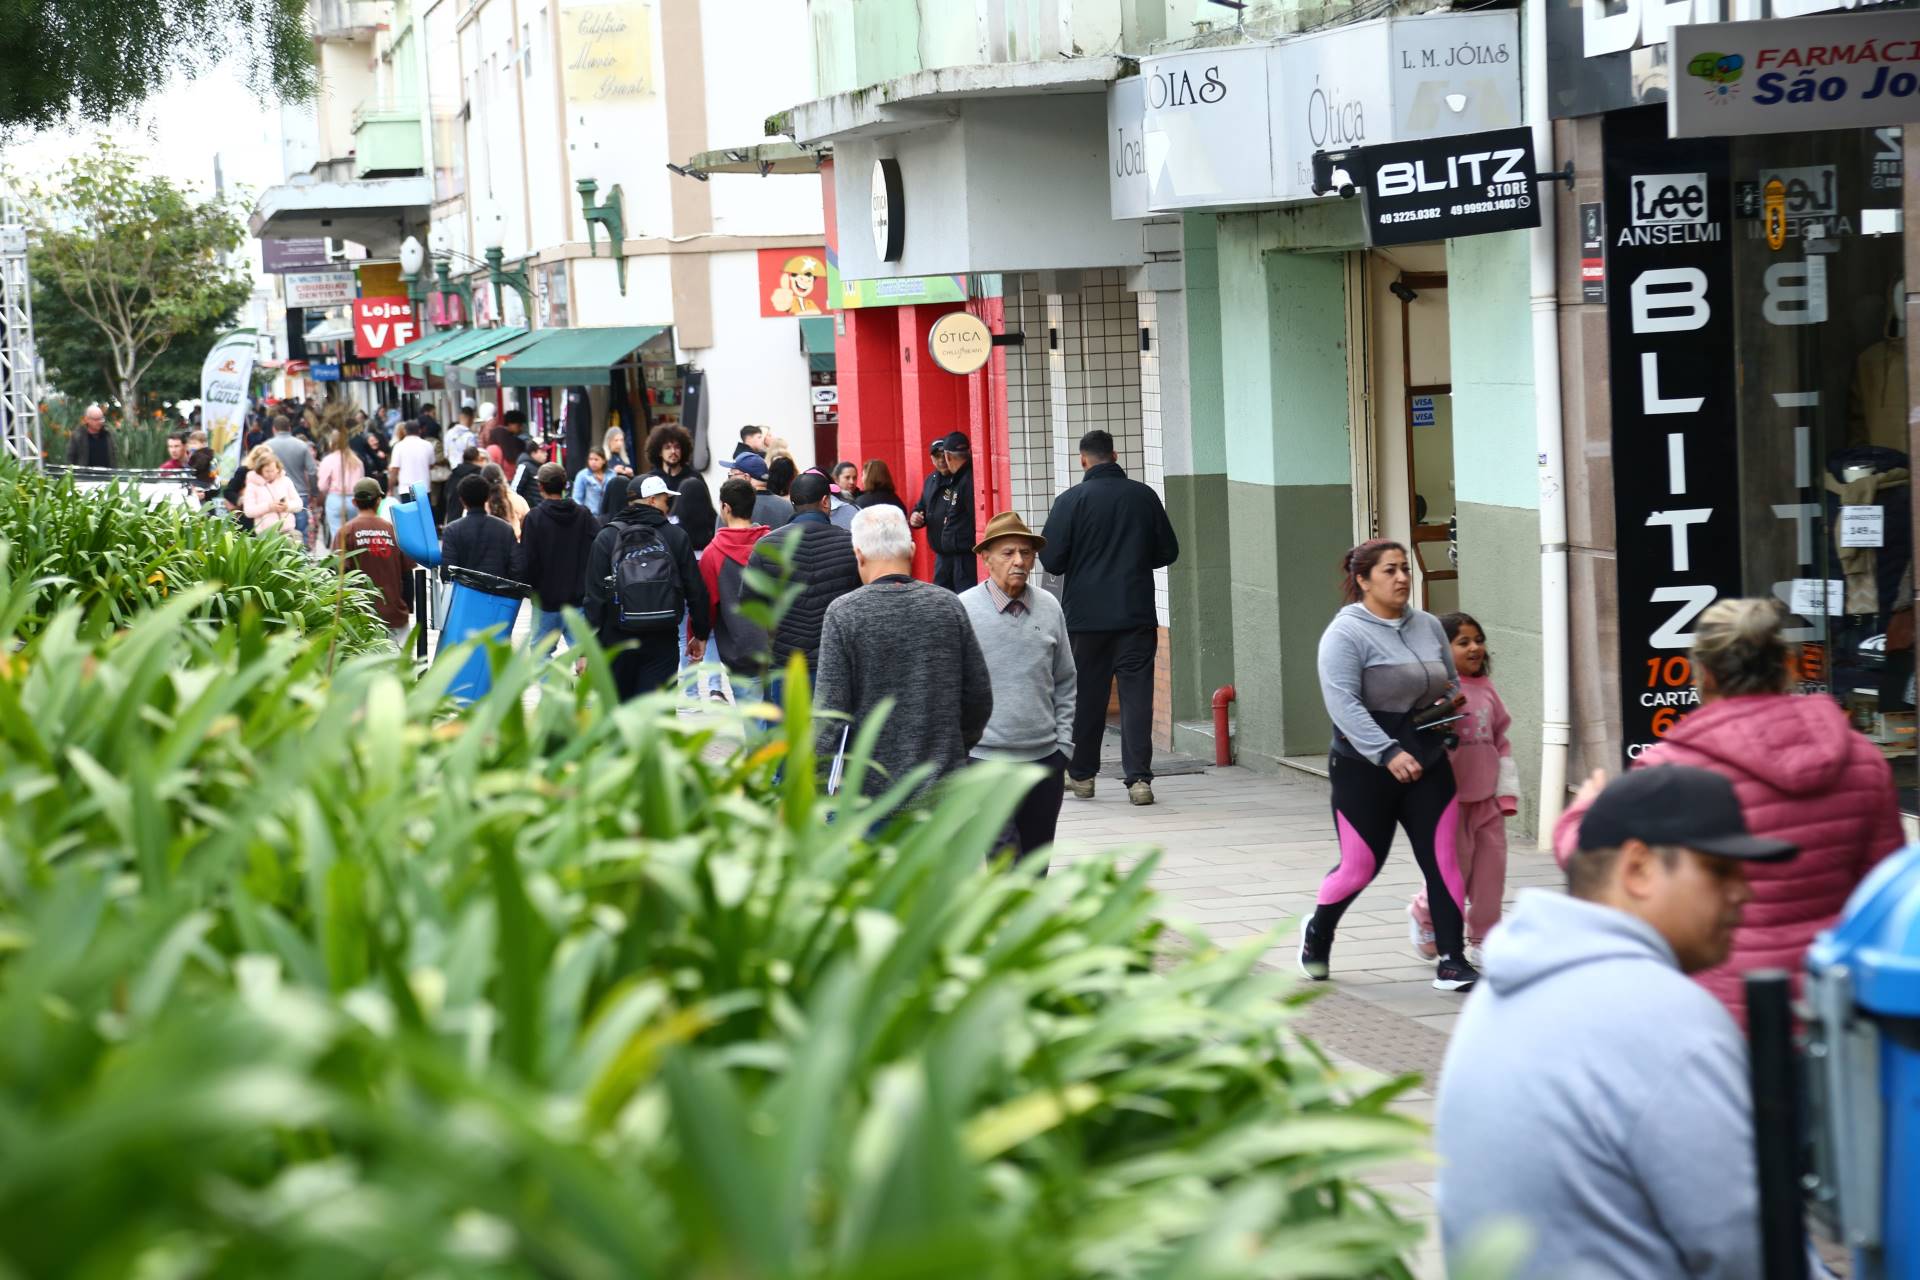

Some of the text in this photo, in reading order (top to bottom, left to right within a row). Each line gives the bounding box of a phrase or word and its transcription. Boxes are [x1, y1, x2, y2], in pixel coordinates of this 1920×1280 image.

[1445, 42, 1510, 66] JÓIAS
[1145, 65, 1227, 112] ÓIAS
[1753, 66, 1920, 105] São Jo
[1308, 74, 1366, 148] Ótica
[1376, 148, 1527, 197] BLITZ
[1487, 181, 1528, 198] STORE
[1634, 180, 1704, 220] Lee
[1380, 213, 1392, 224] 49
[1393, 208, 1441, 223] 3225.0382
[1451, 205, 1463, 215] 49
[1617, 222, 1721, 247] ANSELMI
[361, 303, 411, 319] Lojas
[939, 330, 981, 345] ÓTICA
[1415, 398, 1433, 406] VISA
[355, 529, 391, 538] ORIGINAL
[1646, 655, 1698, 688] 10
[1640, 687, 1701, 707] CARTÃ
[1652, 707, 1689, 738] 6
